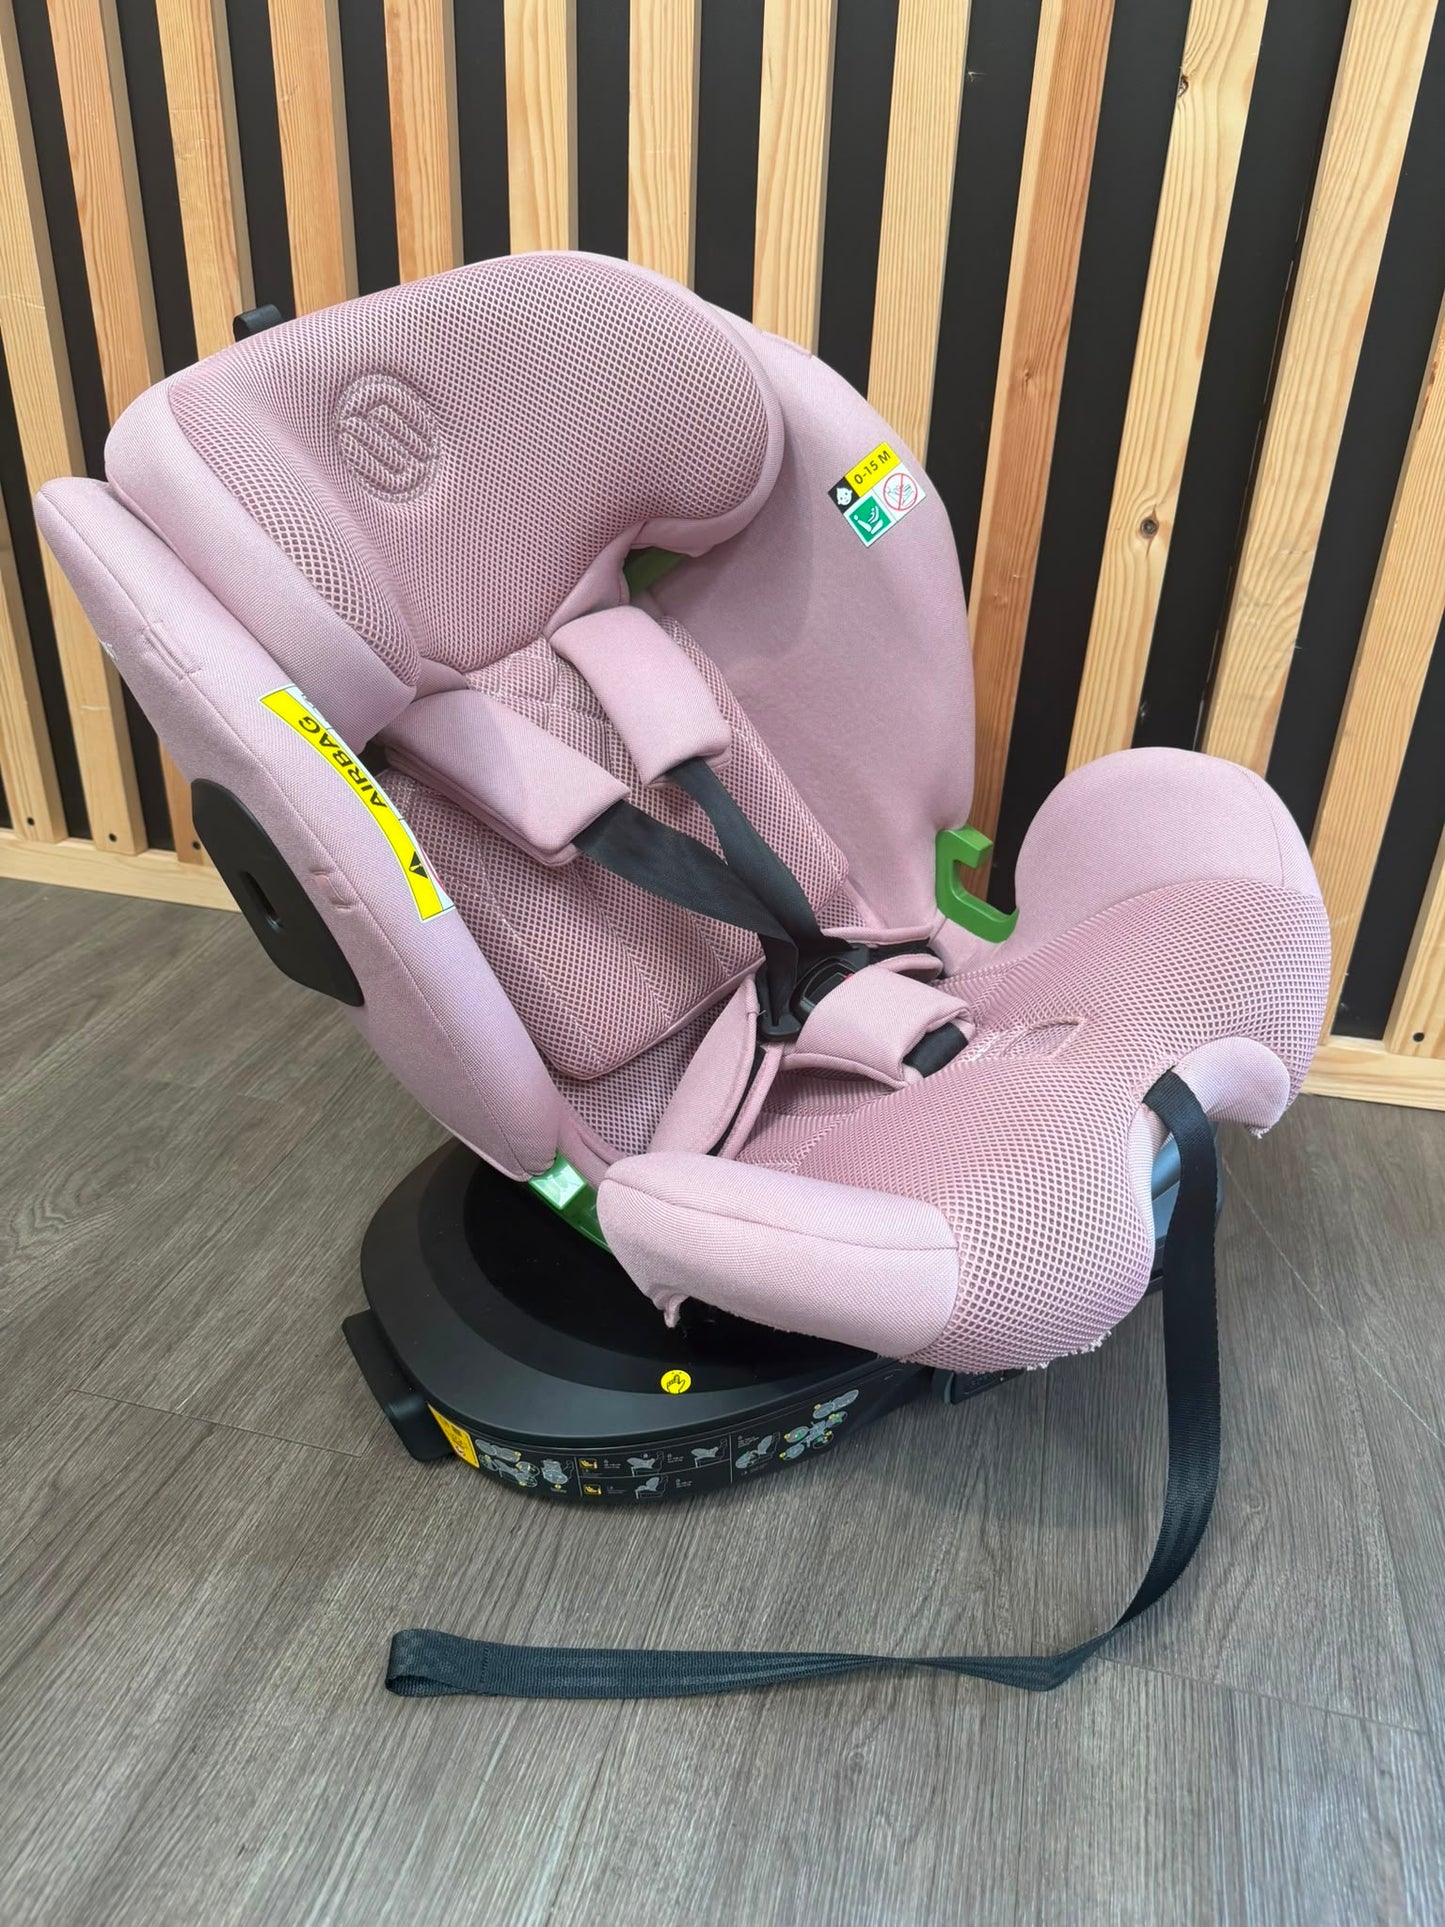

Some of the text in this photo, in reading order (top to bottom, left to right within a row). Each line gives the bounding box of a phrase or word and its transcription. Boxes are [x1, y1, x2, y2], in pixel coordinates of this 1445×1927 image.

[853, 450, 891, 485] 0-15 M
[298, 716, 388, 809] AIRBAG
